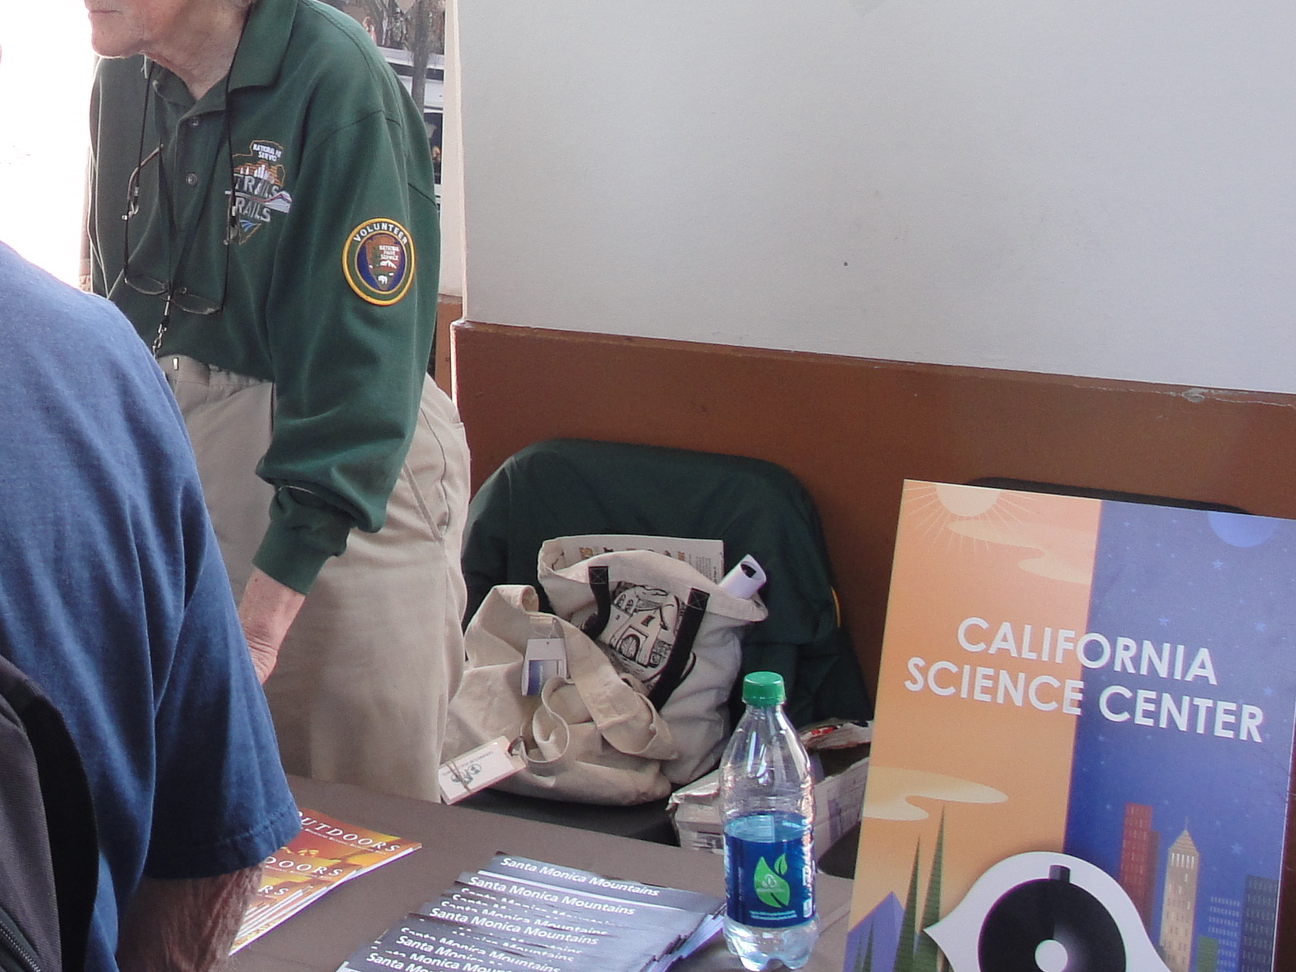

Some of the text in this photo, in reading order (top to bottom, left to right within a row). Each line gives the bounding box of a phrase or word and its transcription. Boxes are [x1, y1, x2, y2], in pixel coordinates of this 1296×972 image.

[235, 196, 271, 222] RAILS
[352, 222, 408, 245] VOLUNTEER
[957, 616, 1218, 685] CALIFORNIA
[904, 656, 1264, 743] SCIENCE CENTER
[500, 857, 661, 897] Santa Monica Mountains
[468, 876, 507, 892] Santa
[509, 885, 559, 902] Monica
[561, 896, 636, 915] Mountains
[429, 907, 600, 945] Santa Monica Mountains
[395, 935, 435, 953] Santa
[366, 952, 405, 970] Santa
[410, 953, 460, 970] Monica
